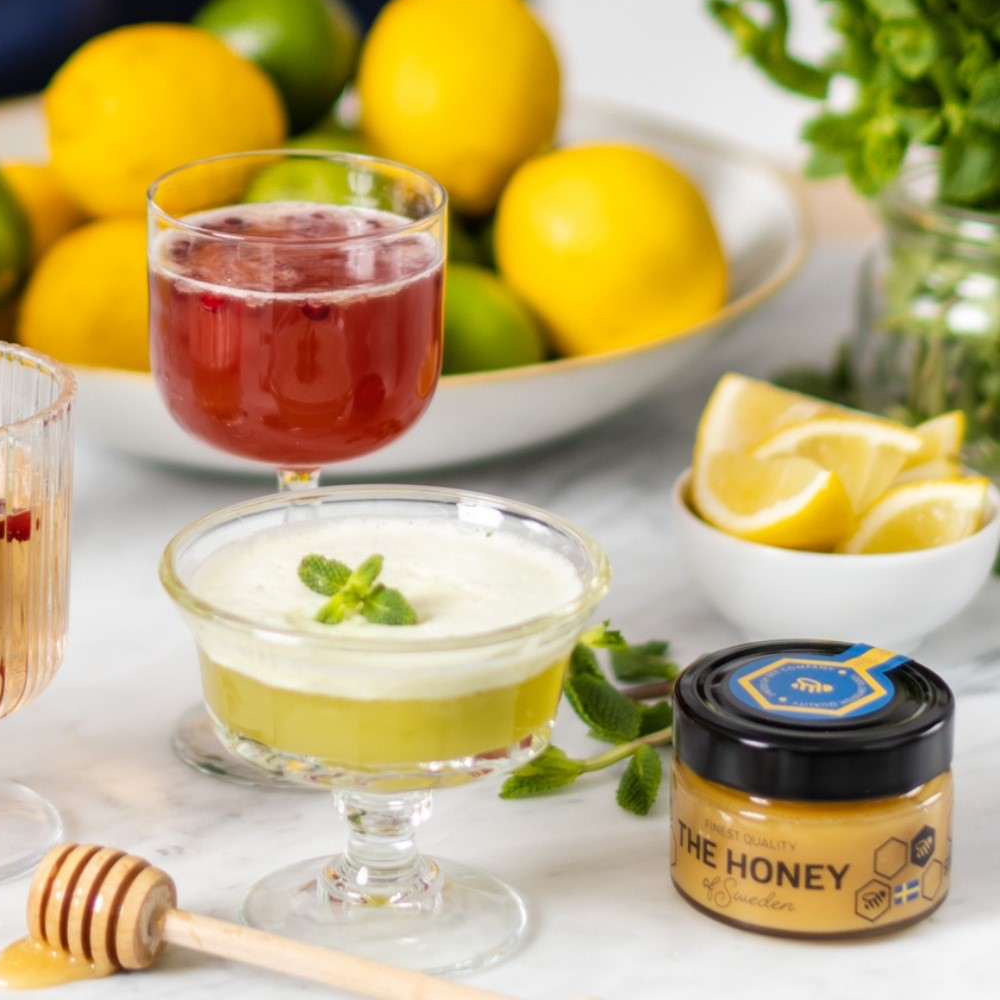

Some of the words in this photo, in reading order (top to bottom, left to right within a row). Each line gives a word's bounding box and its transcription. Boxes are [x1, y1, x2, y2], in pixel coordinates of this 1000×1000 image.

[705, 819, 740, 840] FINEST
[744, 833, 797, 850] QUALITY
[678, 819, 717, 869] THE
[726, 848, 850, 890] HONEY
[703, 876, 720, 900] of
[714, 877, 795, 911] Sweden
